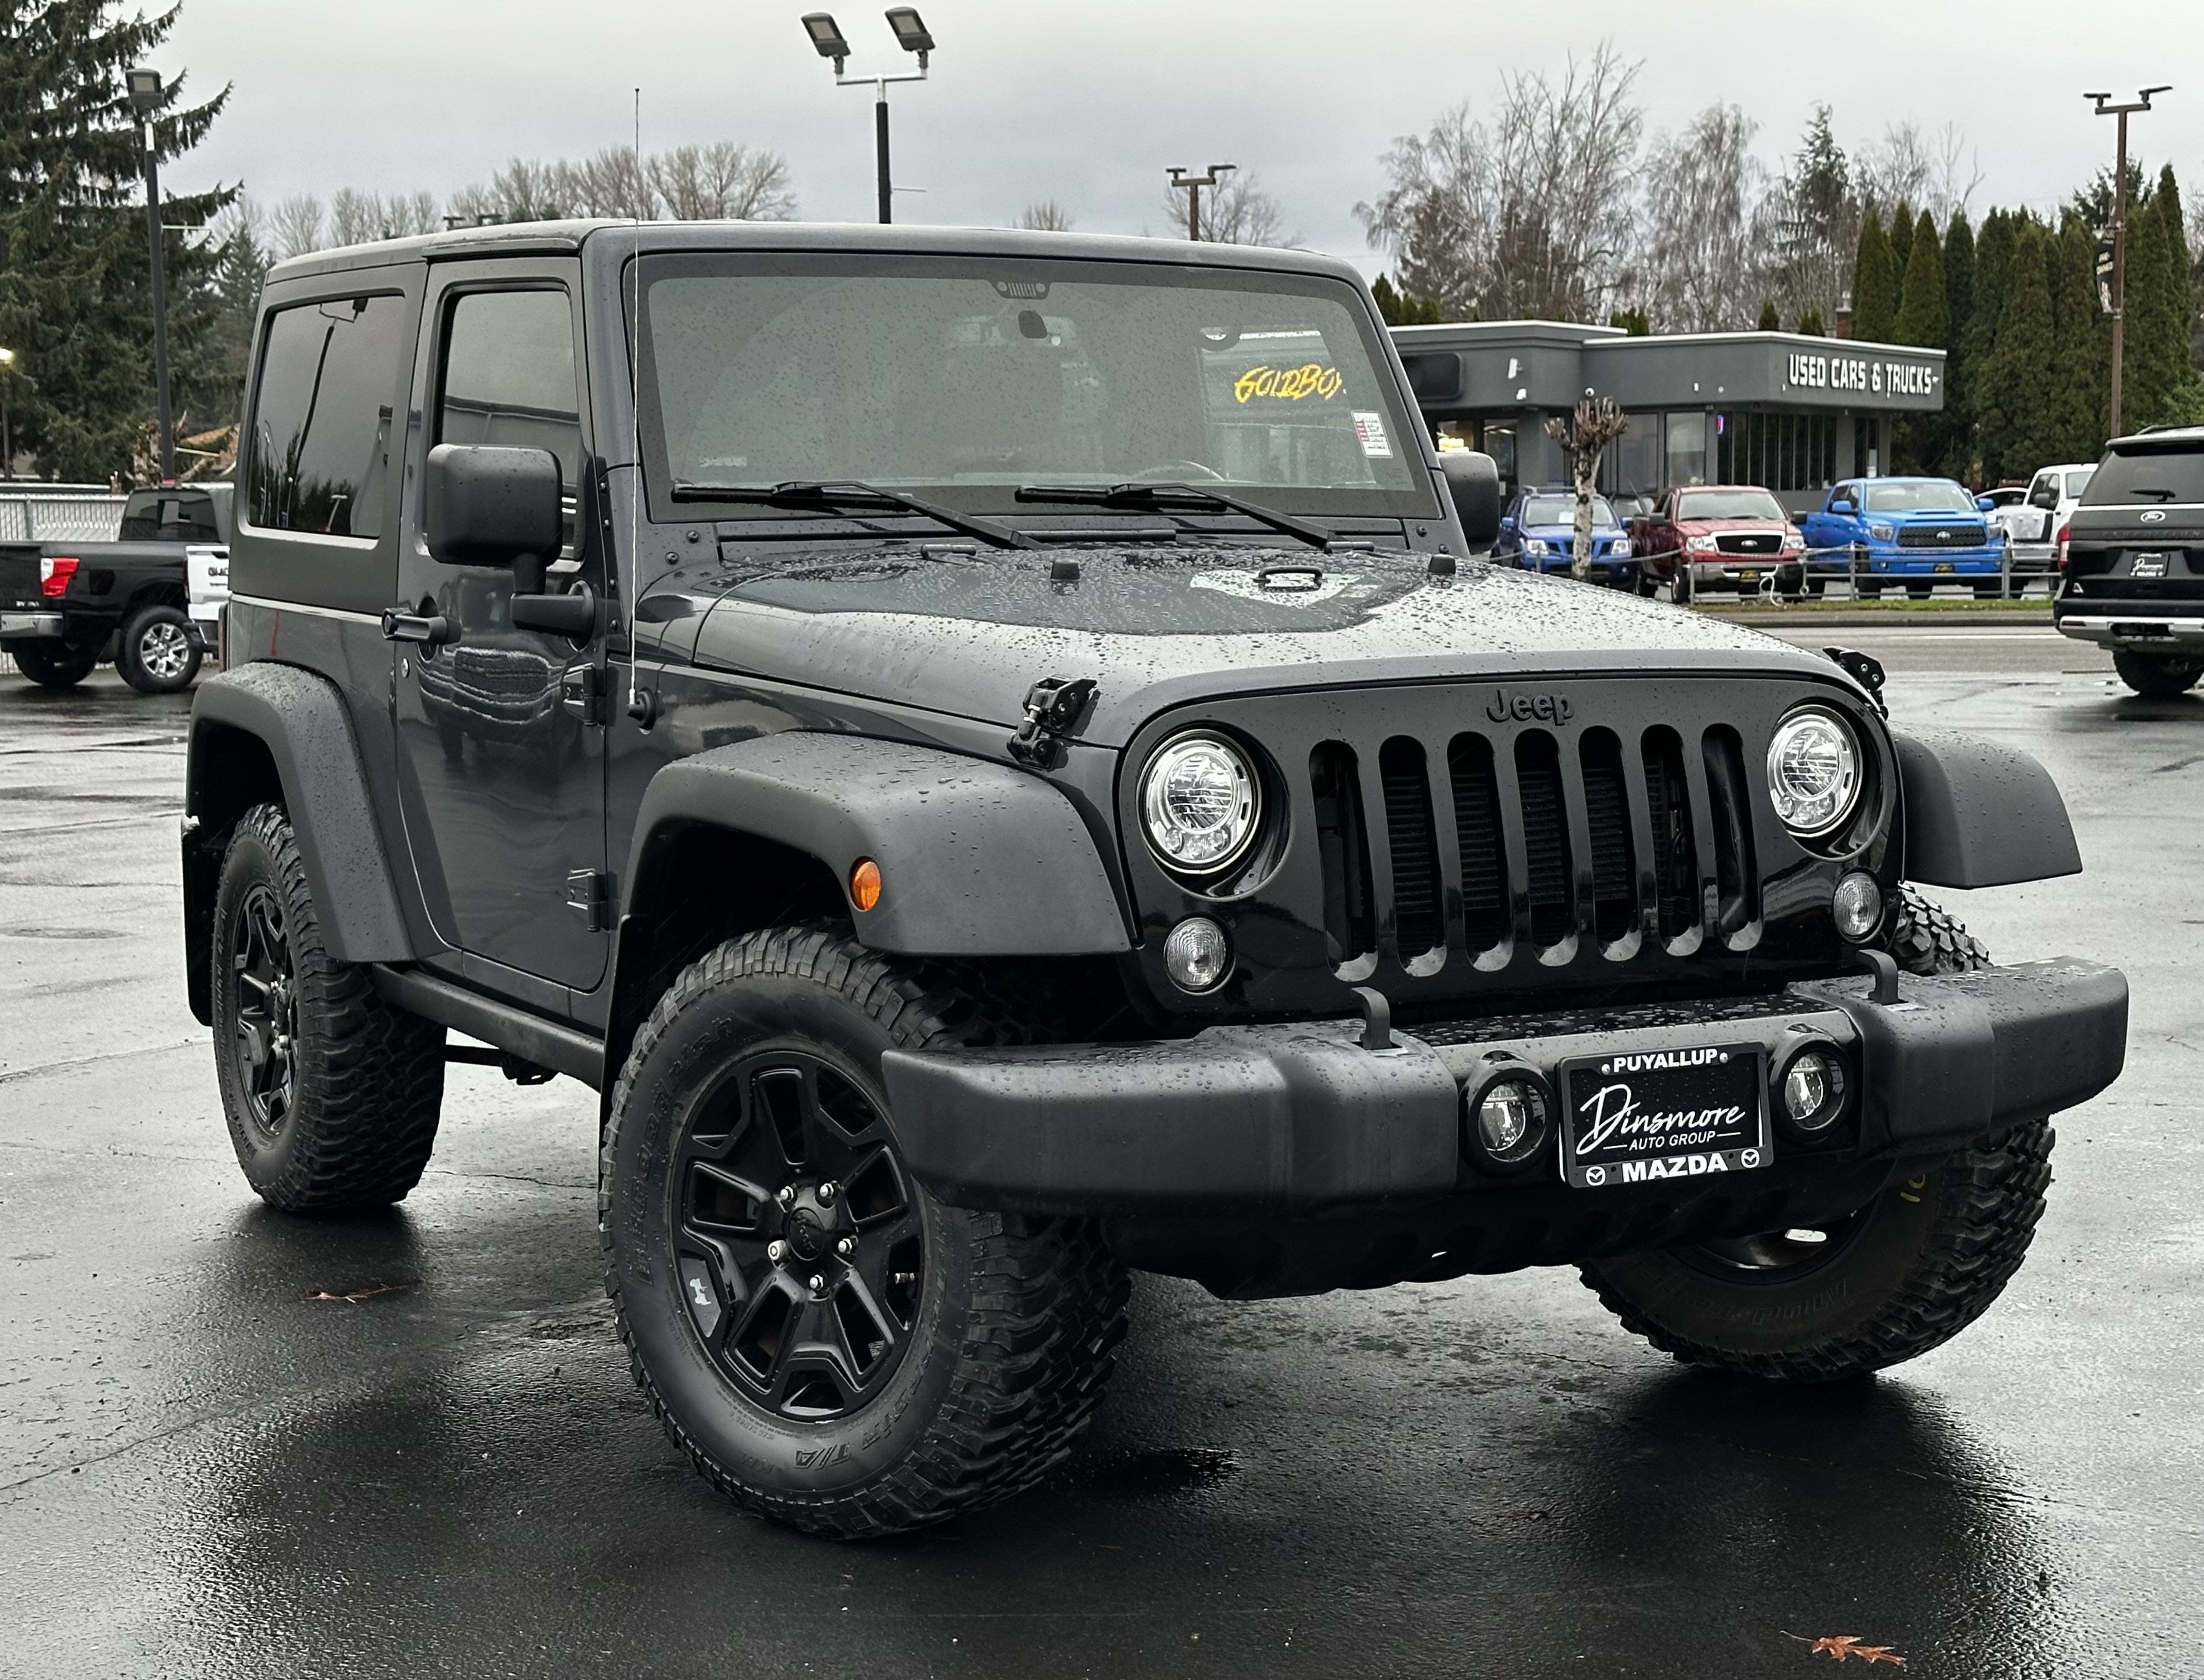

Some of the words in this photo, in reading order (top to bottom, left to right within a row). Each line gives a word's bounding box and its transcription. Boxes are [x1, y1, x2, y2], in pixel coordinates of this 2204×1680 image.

[1789, 353, 1826, 387] USED
[1830, 357, 1866, 390] CARS
[1871, 362, 1881, 392] &
[1885, 363, 1932, 394] TRUCKS
[1485, 689, 1575, 726] Jeep
[1612, 1049, 1718, 1073] PUYALLUP
[1576, 1084, 1746, 1155] Dinsmore
[1628, 1135, 1665, 1152] AUTO
[1668, 1131, 1716, 1147] GROUP
[1622, 1152, 1729, 1183] MAZDA
